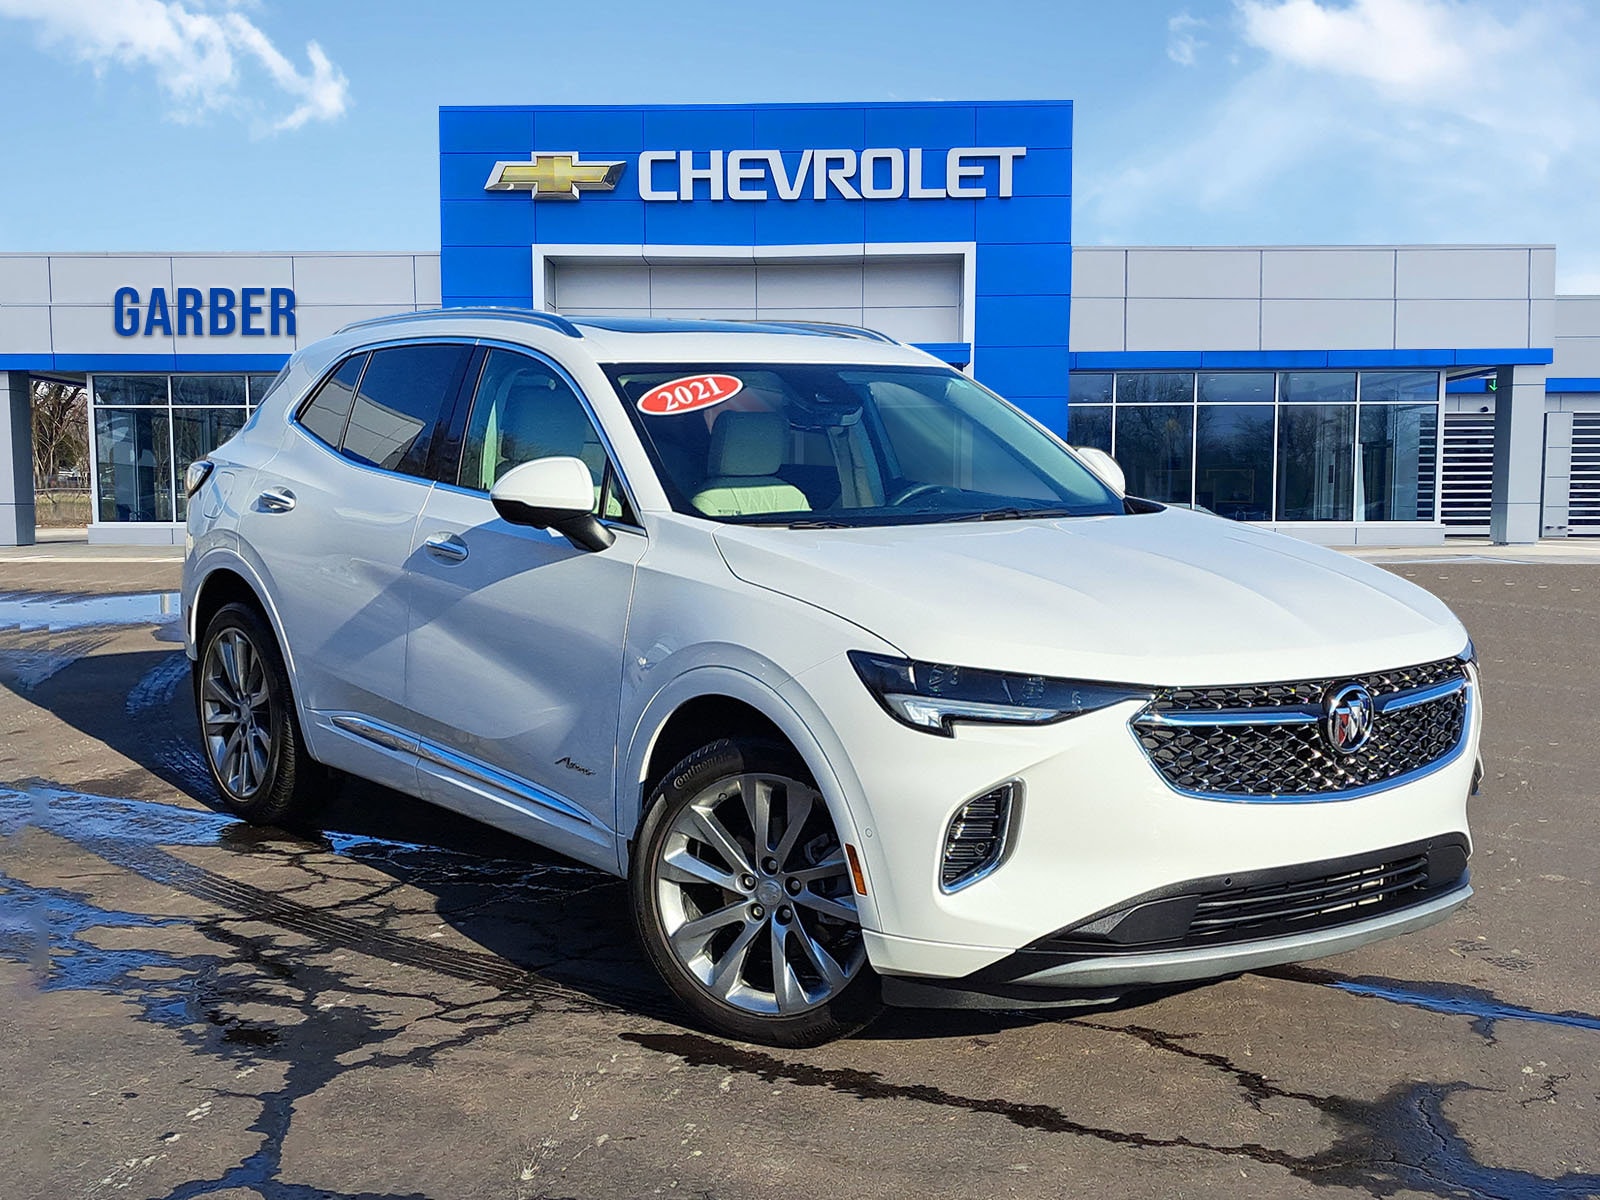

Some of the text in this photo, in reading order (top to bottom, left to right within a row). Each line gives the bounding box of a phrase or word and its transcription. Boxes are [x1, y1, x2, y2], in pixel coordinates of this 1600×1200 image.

[638, 146, 1027, 201] CHEVROLET
[114, 286, 297, 337] GARBER
[657, 377, 724, 411] 2021
